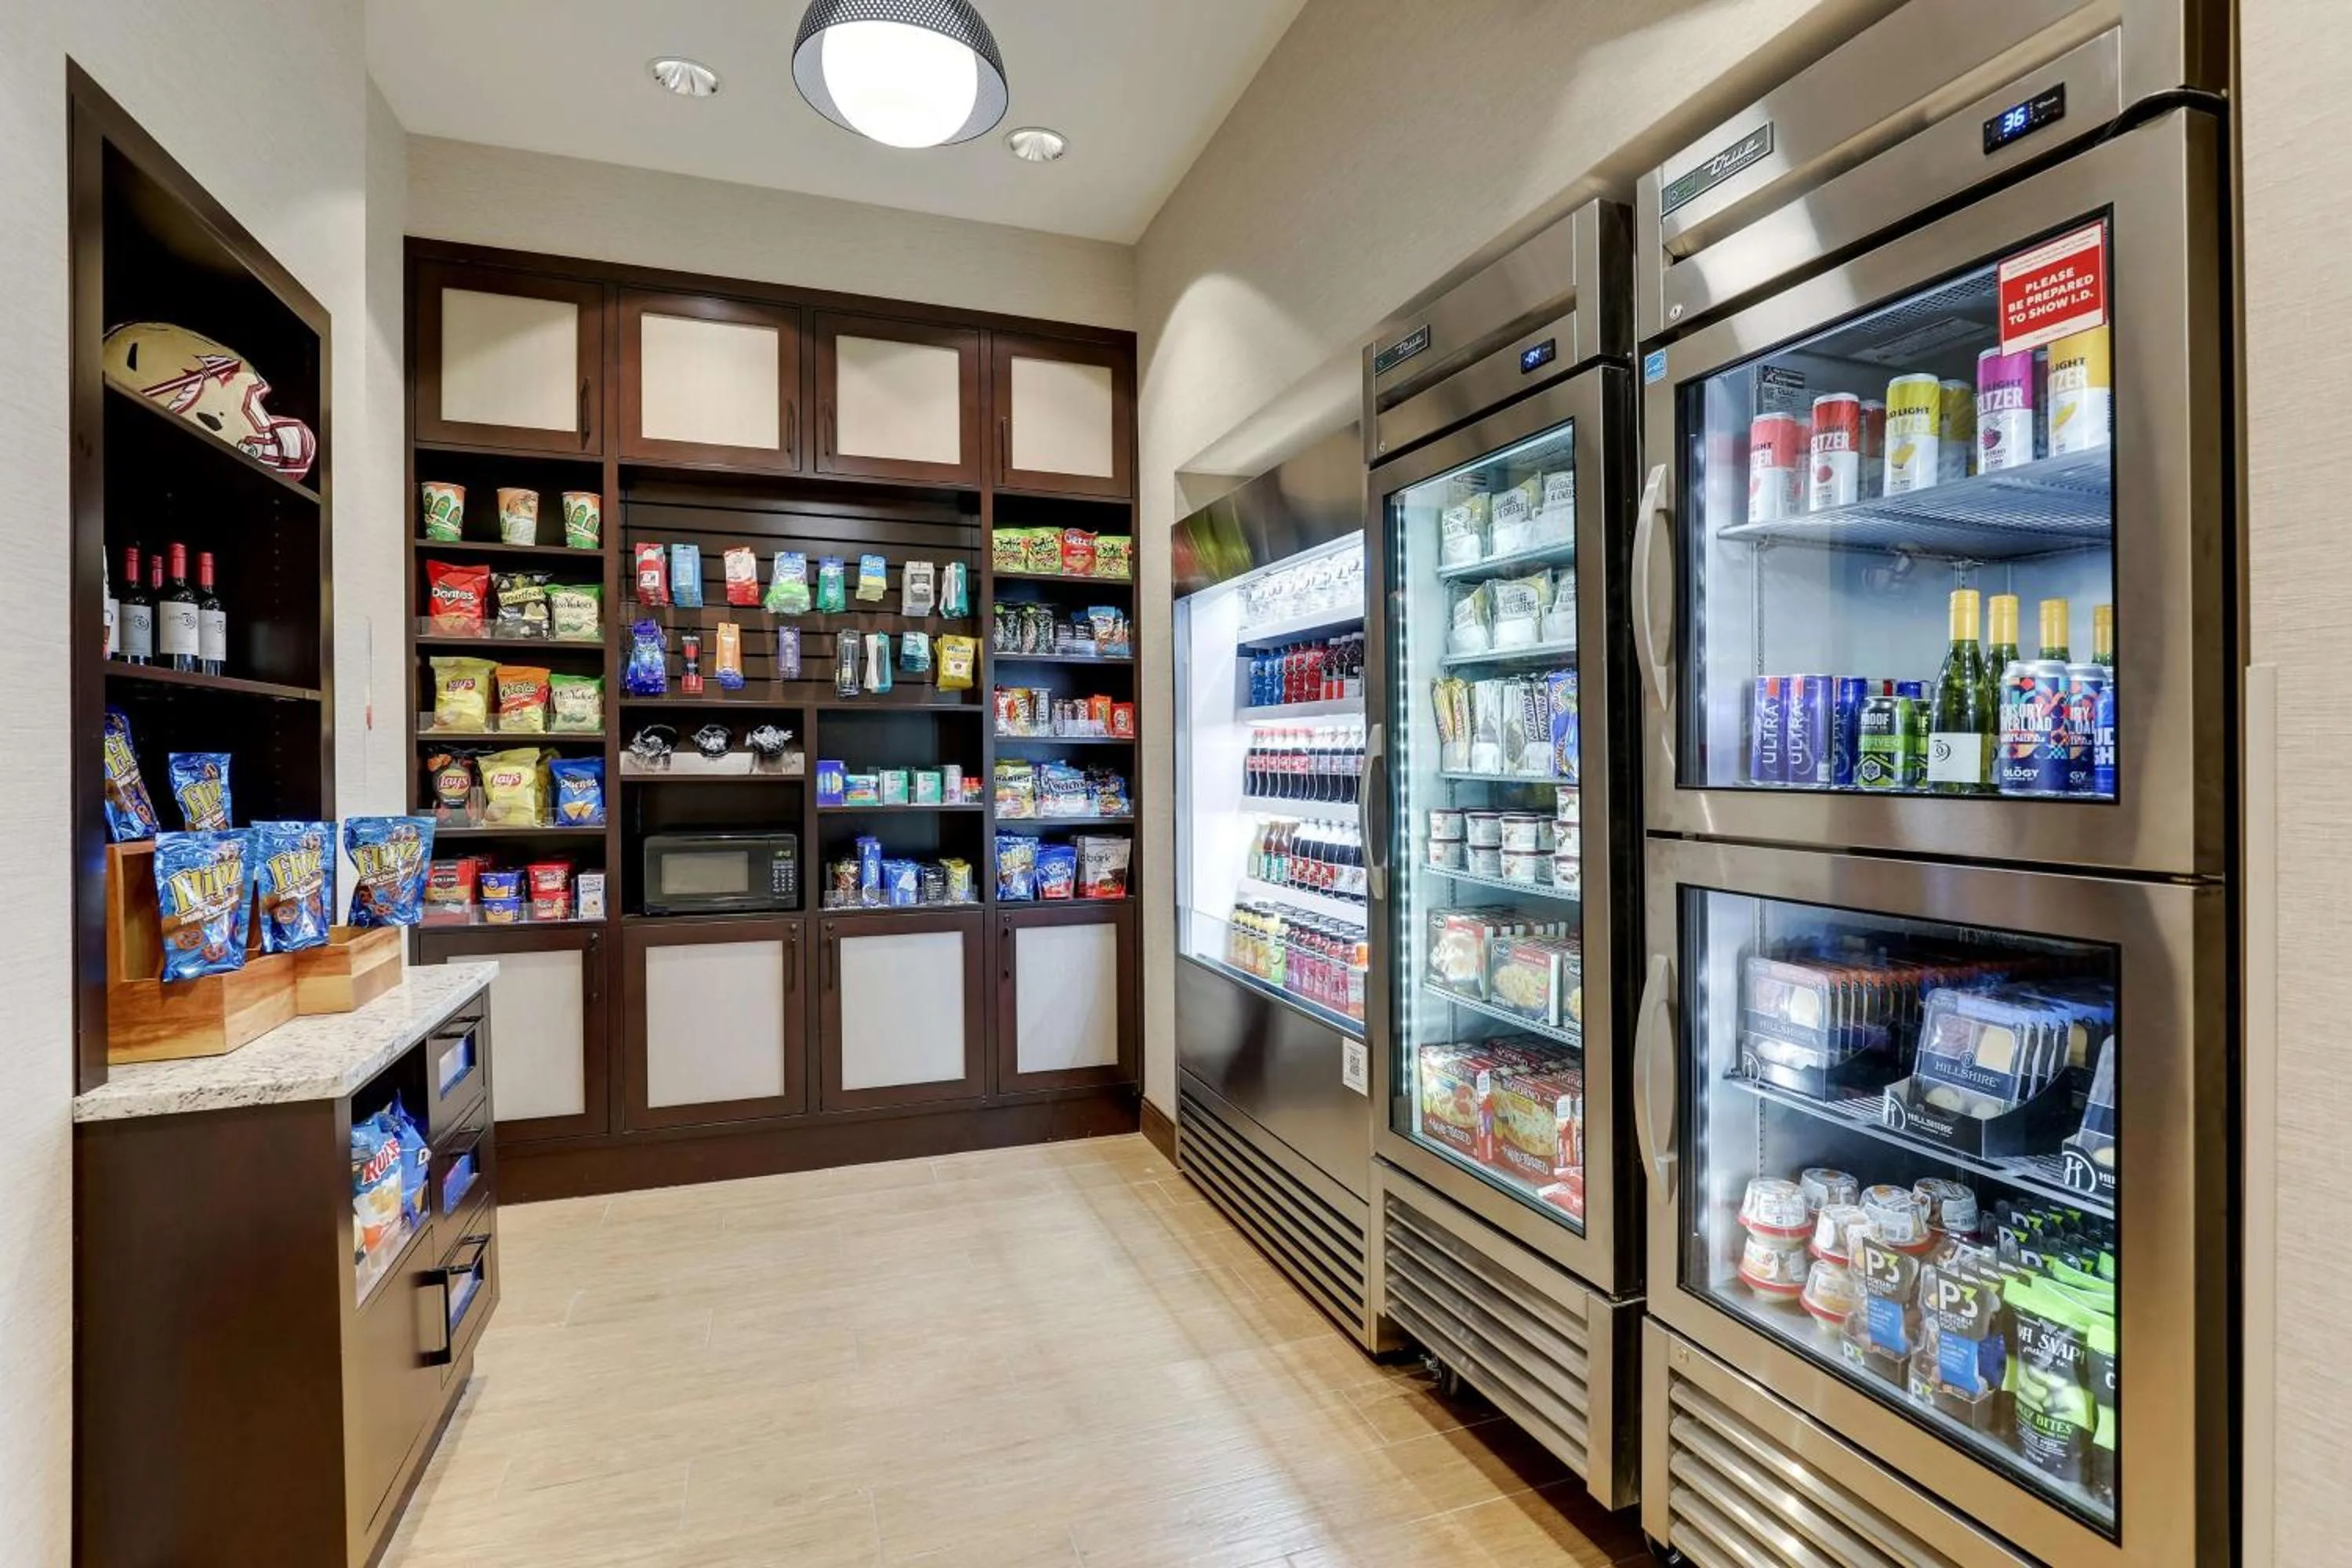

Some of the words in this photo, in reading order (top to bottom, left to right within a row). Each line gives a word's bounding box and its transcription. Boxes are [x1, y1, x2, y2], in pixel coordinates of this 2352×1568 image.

[2003, 107, 2025, 132] 36
[2025, 267, 2074, 293] PLEASE
[2008, 300, 2024, 313] BE
[2026, 274, 2094, 306] PREPARED
[2009, 314, 2027, 325] TO
[2028, 296, 2069, 319] SHOW
[2071, 289, 2094, 303] I.D.
[2048, 367, 2086, 394] TZER
[1898, 407, 1929, 416] LIGHT
[1977, 387, 2024, 416] ELTZER
[1810, 432, 1849, 453] ELTZER
[432, 586, 475, 603] Doritos
[500, 586, 546, 605] Smartfood
[1762, 704, 1779, 764] ULTRA
[1790, 697, 1803, 764] ULTRA
[1759, 1020, 1795, 1036] HILLSH
[1934, 1061, 1998, 1087] HILLSHIRE
[1907, 1112, 1954, 1135] HILLSHIRE
[1865, 1246, 1900, 1283] P3
[1939, 1278, 1978, 1319] P3
[2038, 1333, 2085, 1365] SNAP!
[2036, 1414, 2073, 1434] BITES
